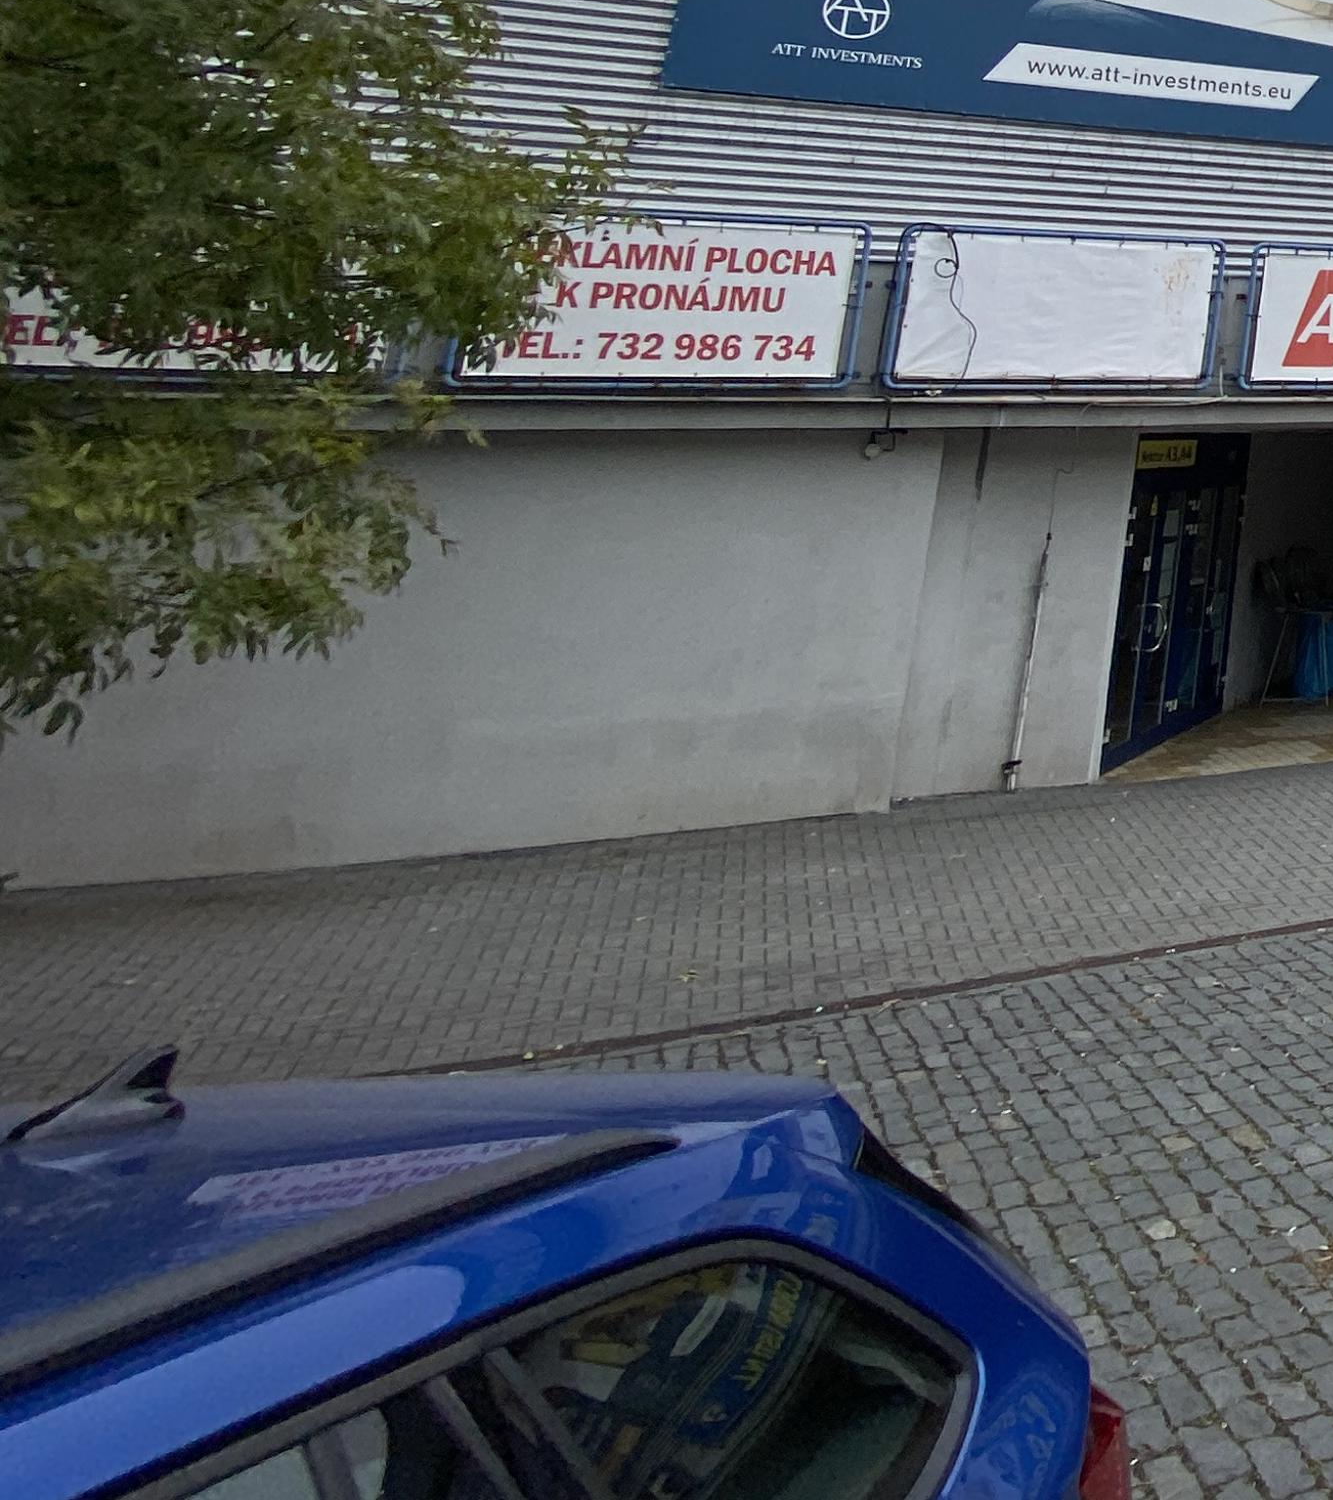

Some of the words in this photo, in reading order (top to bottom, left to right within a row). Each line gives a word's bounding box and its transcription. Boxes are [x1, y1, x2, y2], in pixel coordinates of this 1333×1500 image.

[772, 43, 805, 58] ATT
[811, 46, 923, 68] INVESTMENTS
[1027, 57, 1292, 100] www.att-investments.eu
[704, 247, 837, 277] PLOCHA
[555, 280, 583, 308] K
[589, 278, 786, 312] PRONÁJMU
[598, 332, 663, 361] 732
[674, 333, 743, 361] 986
[753, 335, 816, 361] 734
